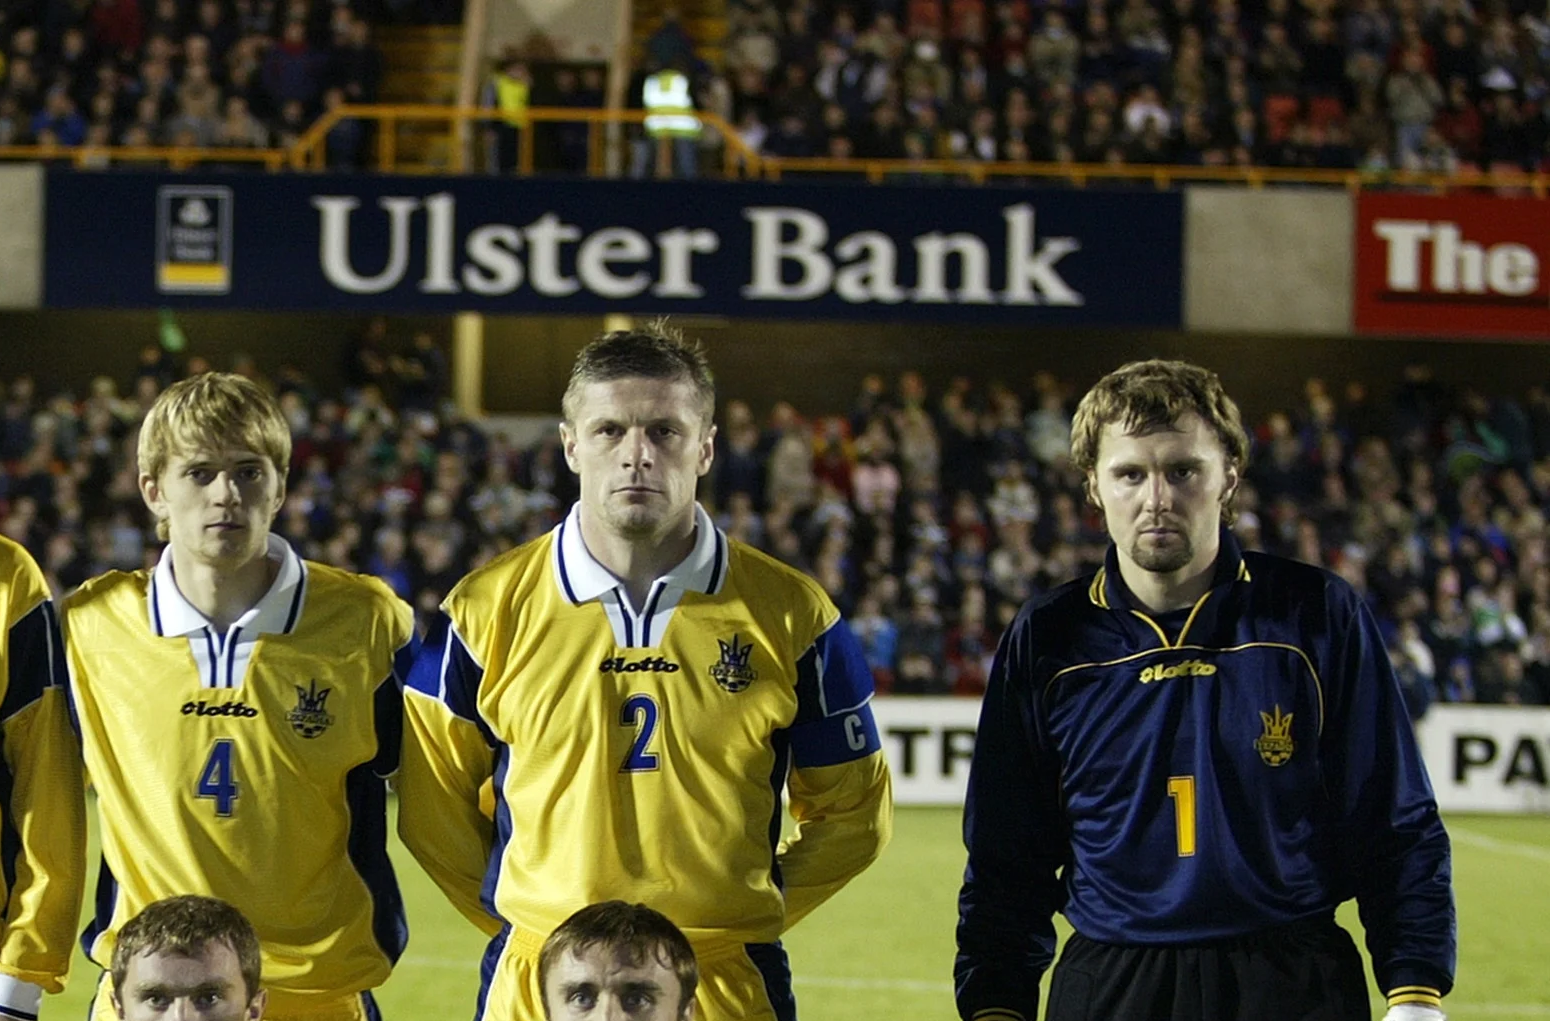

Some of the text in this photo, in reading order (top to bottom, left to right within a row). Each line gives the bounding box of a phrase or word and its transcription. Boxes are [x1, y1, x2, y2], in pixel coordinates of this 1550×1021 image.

[311, 192, 1085, 307] Ulster Bank
[1374, 219, 1538, 296] The
[197, 701, 259, 718] lotto
[618, 693, 661, 773] 2
[843, 714, 866, 751] C
[194, 738, 239, 818] 4
[1167, 775, 1196, 857] 1
